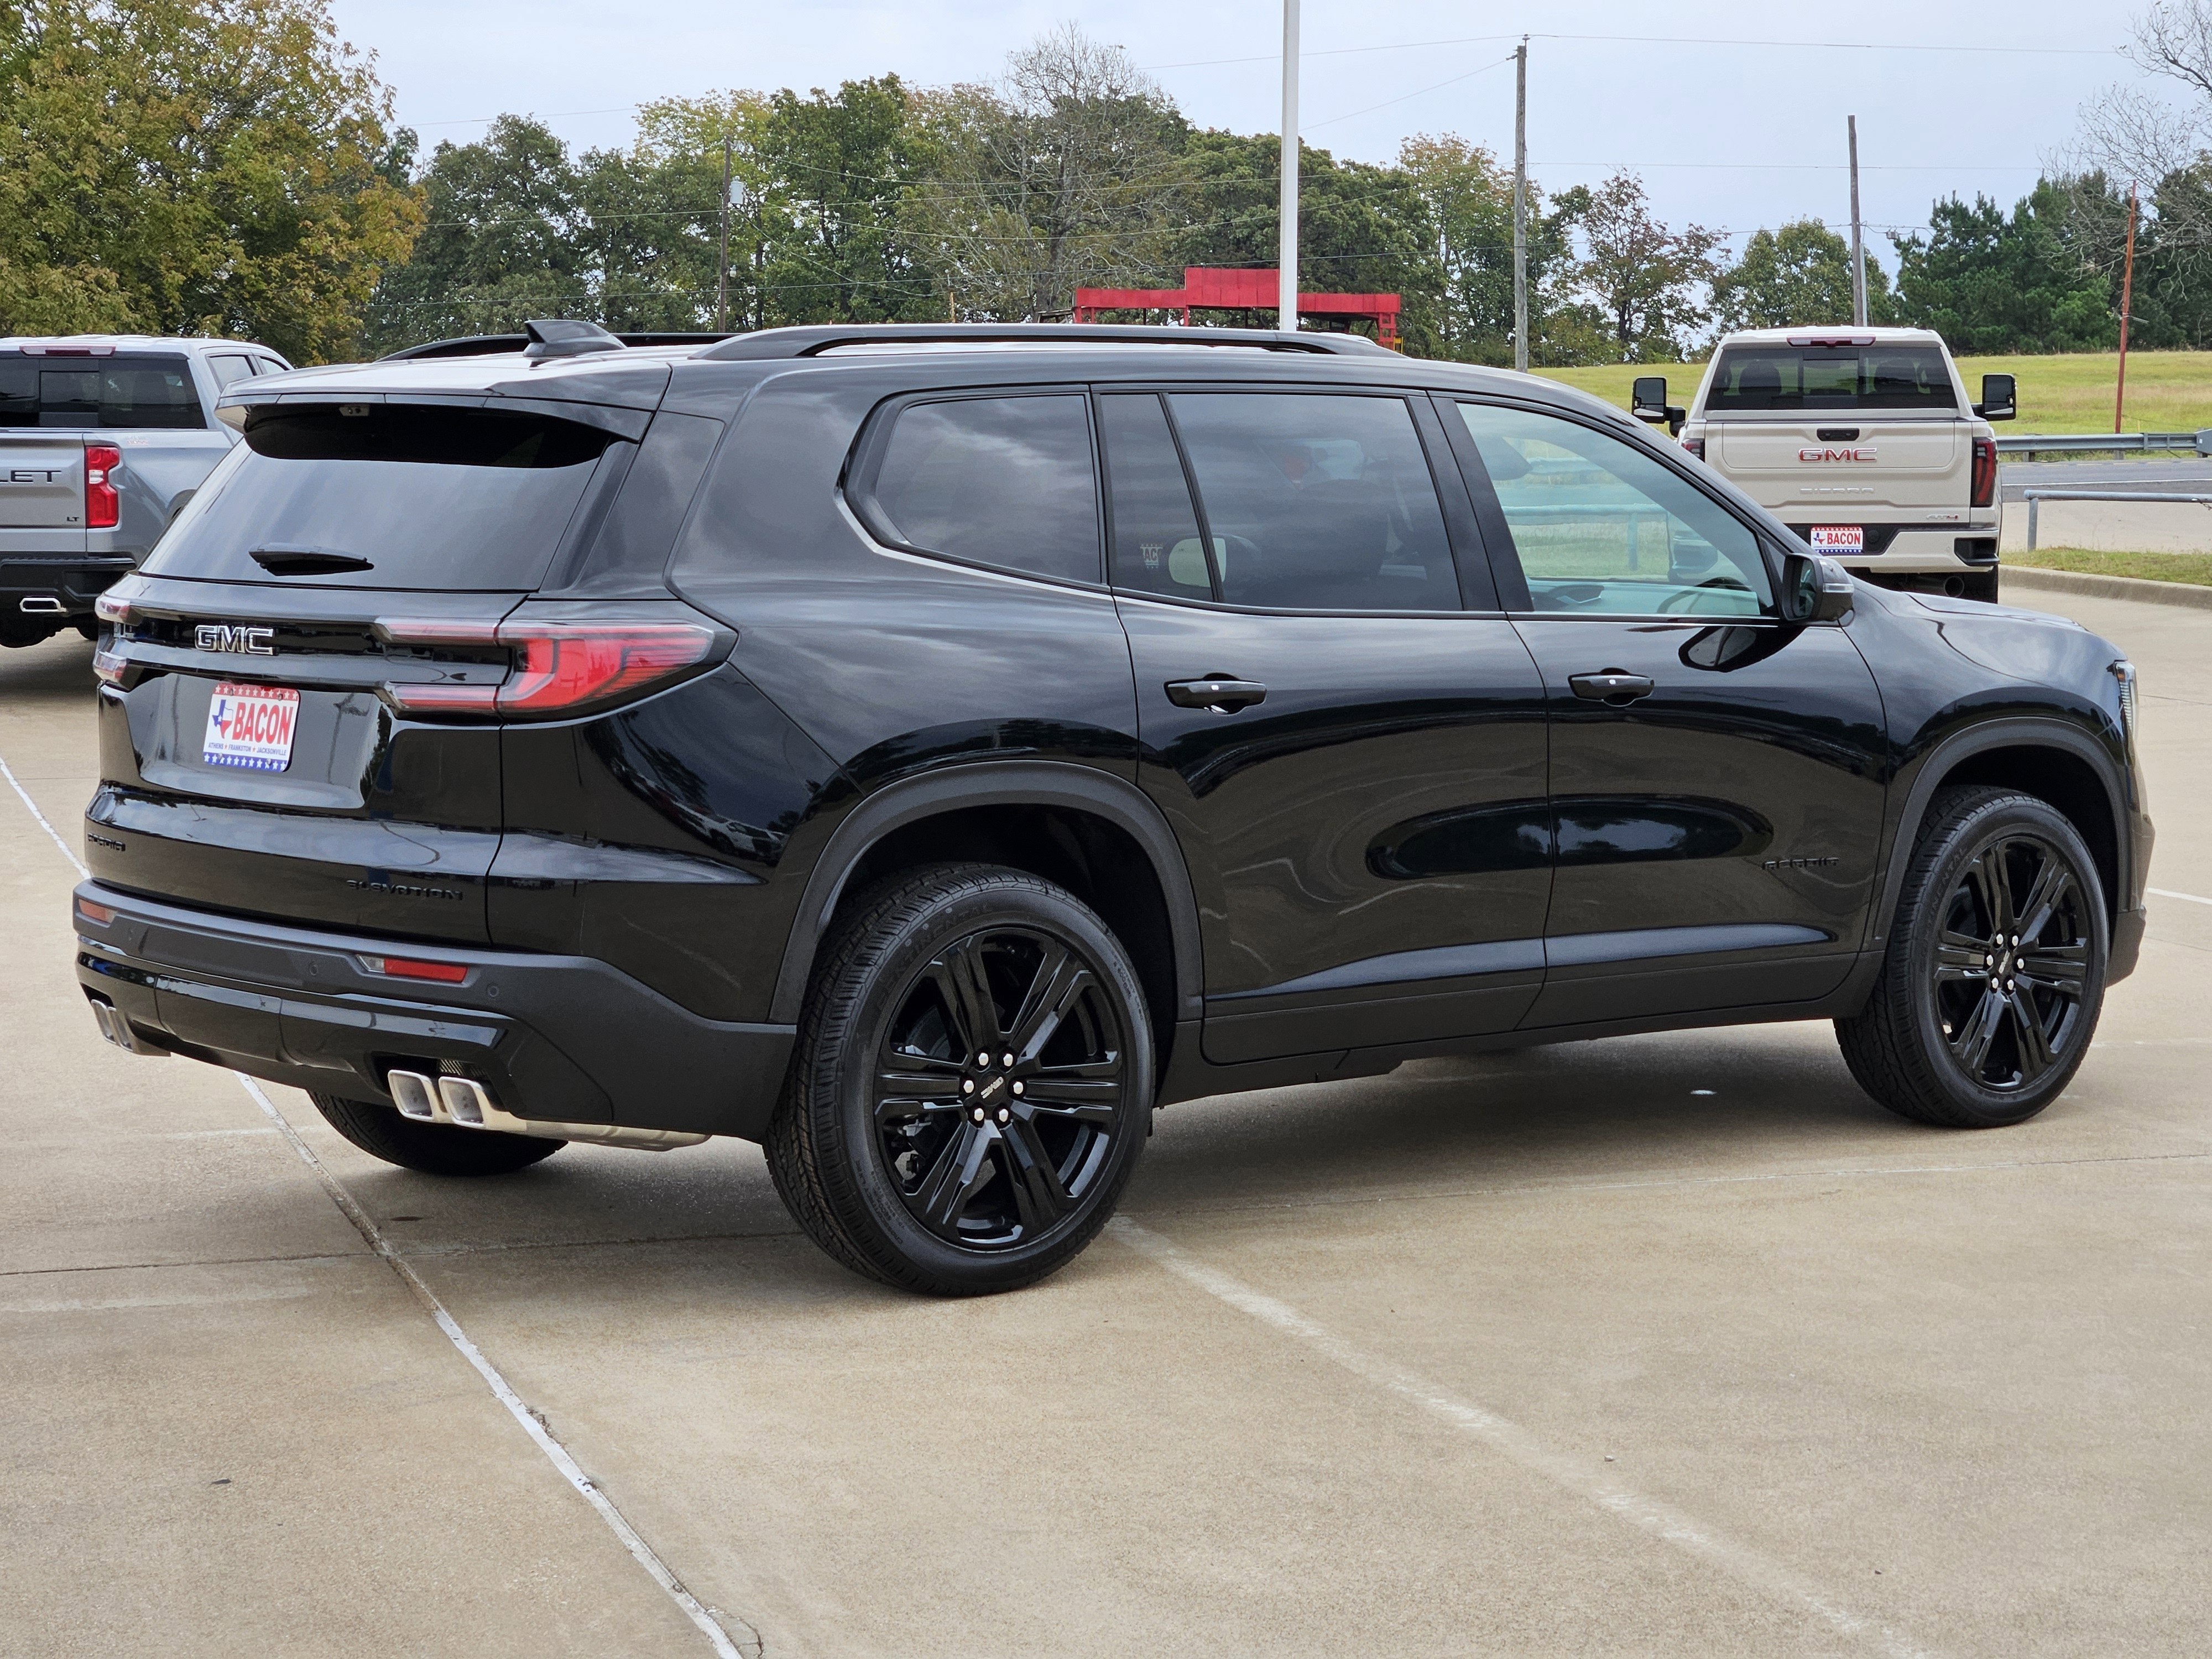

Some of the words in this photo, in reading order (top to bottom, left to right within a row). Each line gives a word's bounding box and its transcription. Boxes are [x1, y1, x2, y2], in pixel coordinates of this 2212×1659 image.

[1798, 448, 1877, 462] GMC
[1827, 533, 1860, 545] BACON
[195, 625, 273, 655] GMC
[232, 702, 294, 745] BACON
[228, 744, 251, 752] FRANKSTON
[257, 747, 287, 755] JACKSONVILLE
[980, 1076, 1004, 1099] GMC
